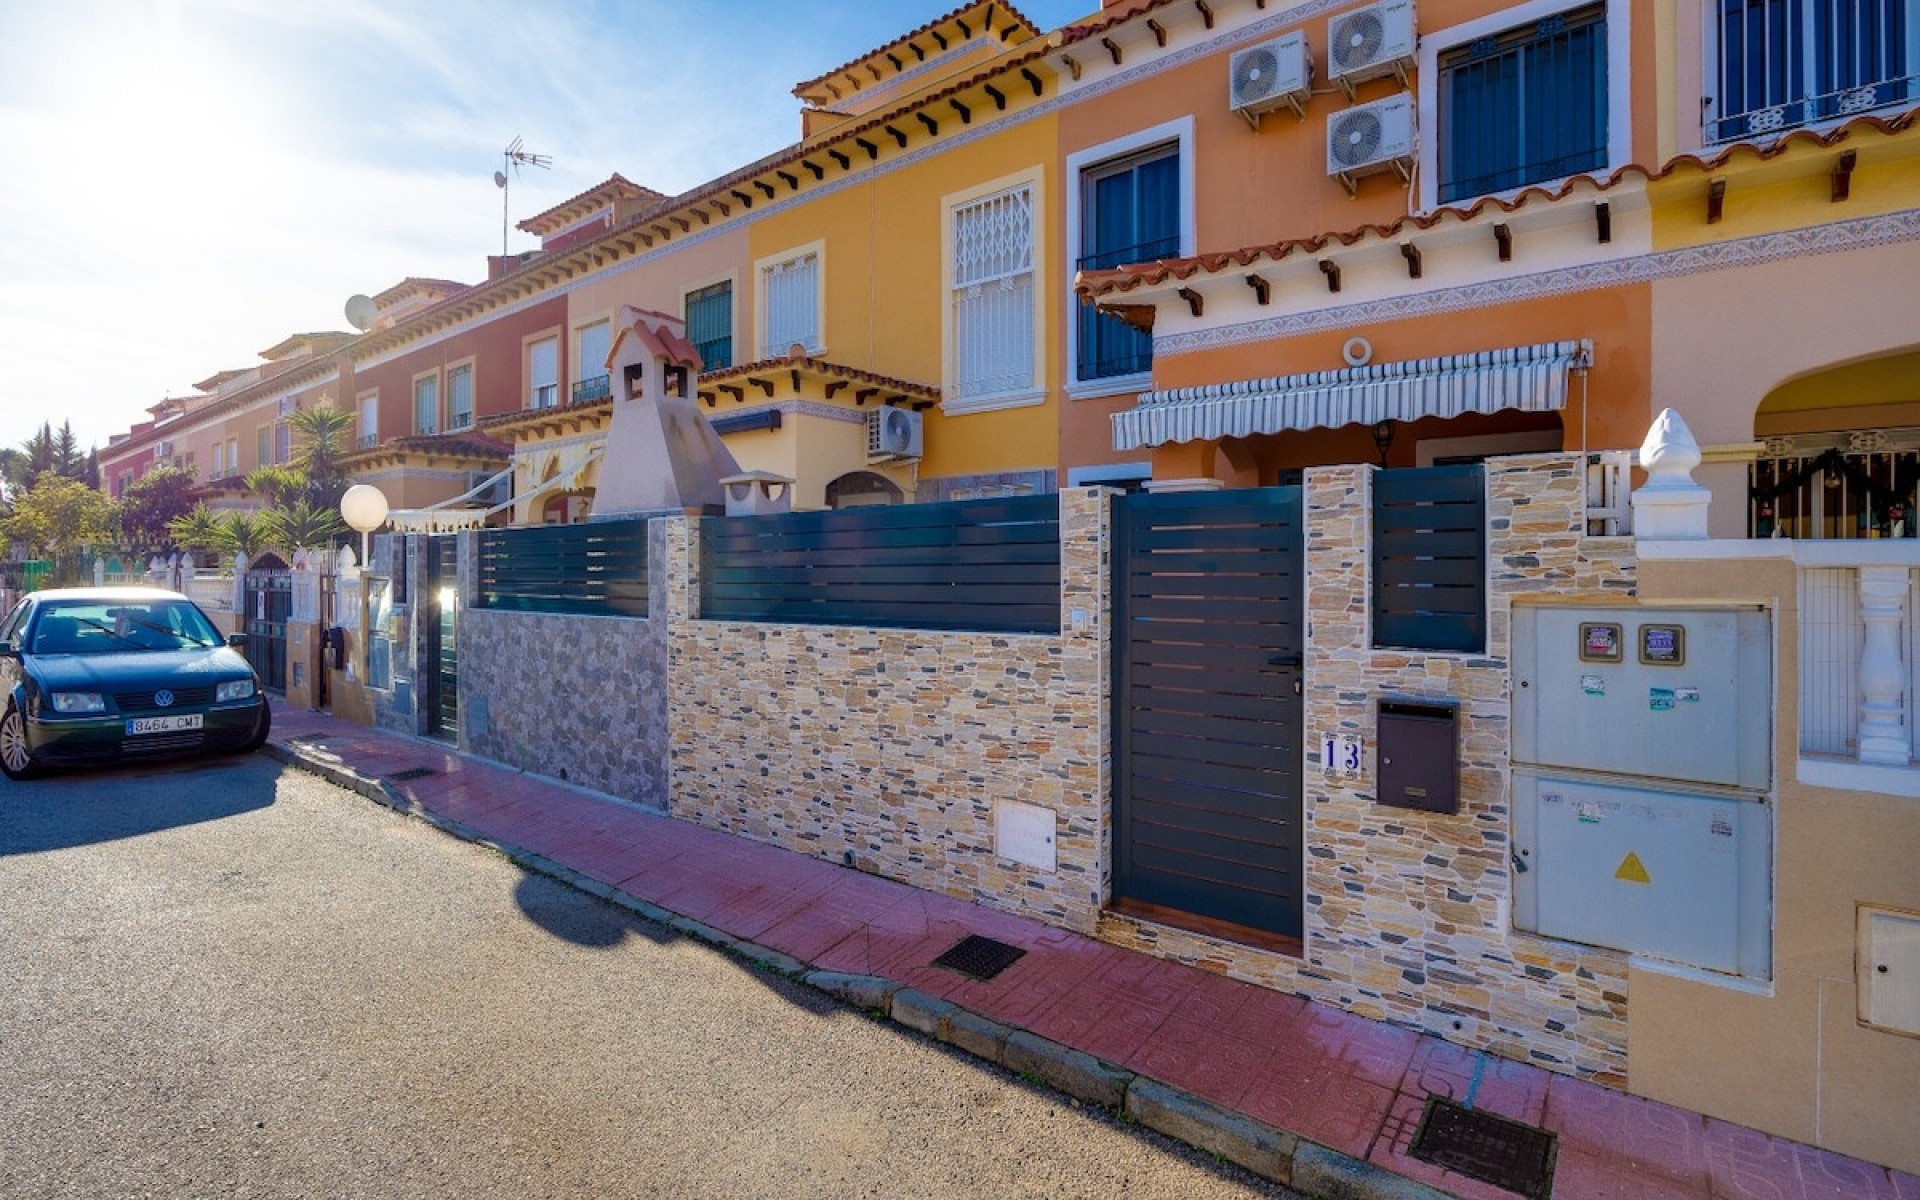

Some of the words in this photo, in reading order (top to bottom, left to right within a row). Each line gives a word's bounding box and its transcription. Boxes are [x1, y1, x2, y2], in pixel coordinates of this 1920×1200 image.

[135, 718, 169, 731] 8464
[177, 716, 200, 729] CMT
[1326, 740, 1359, 769] 13
